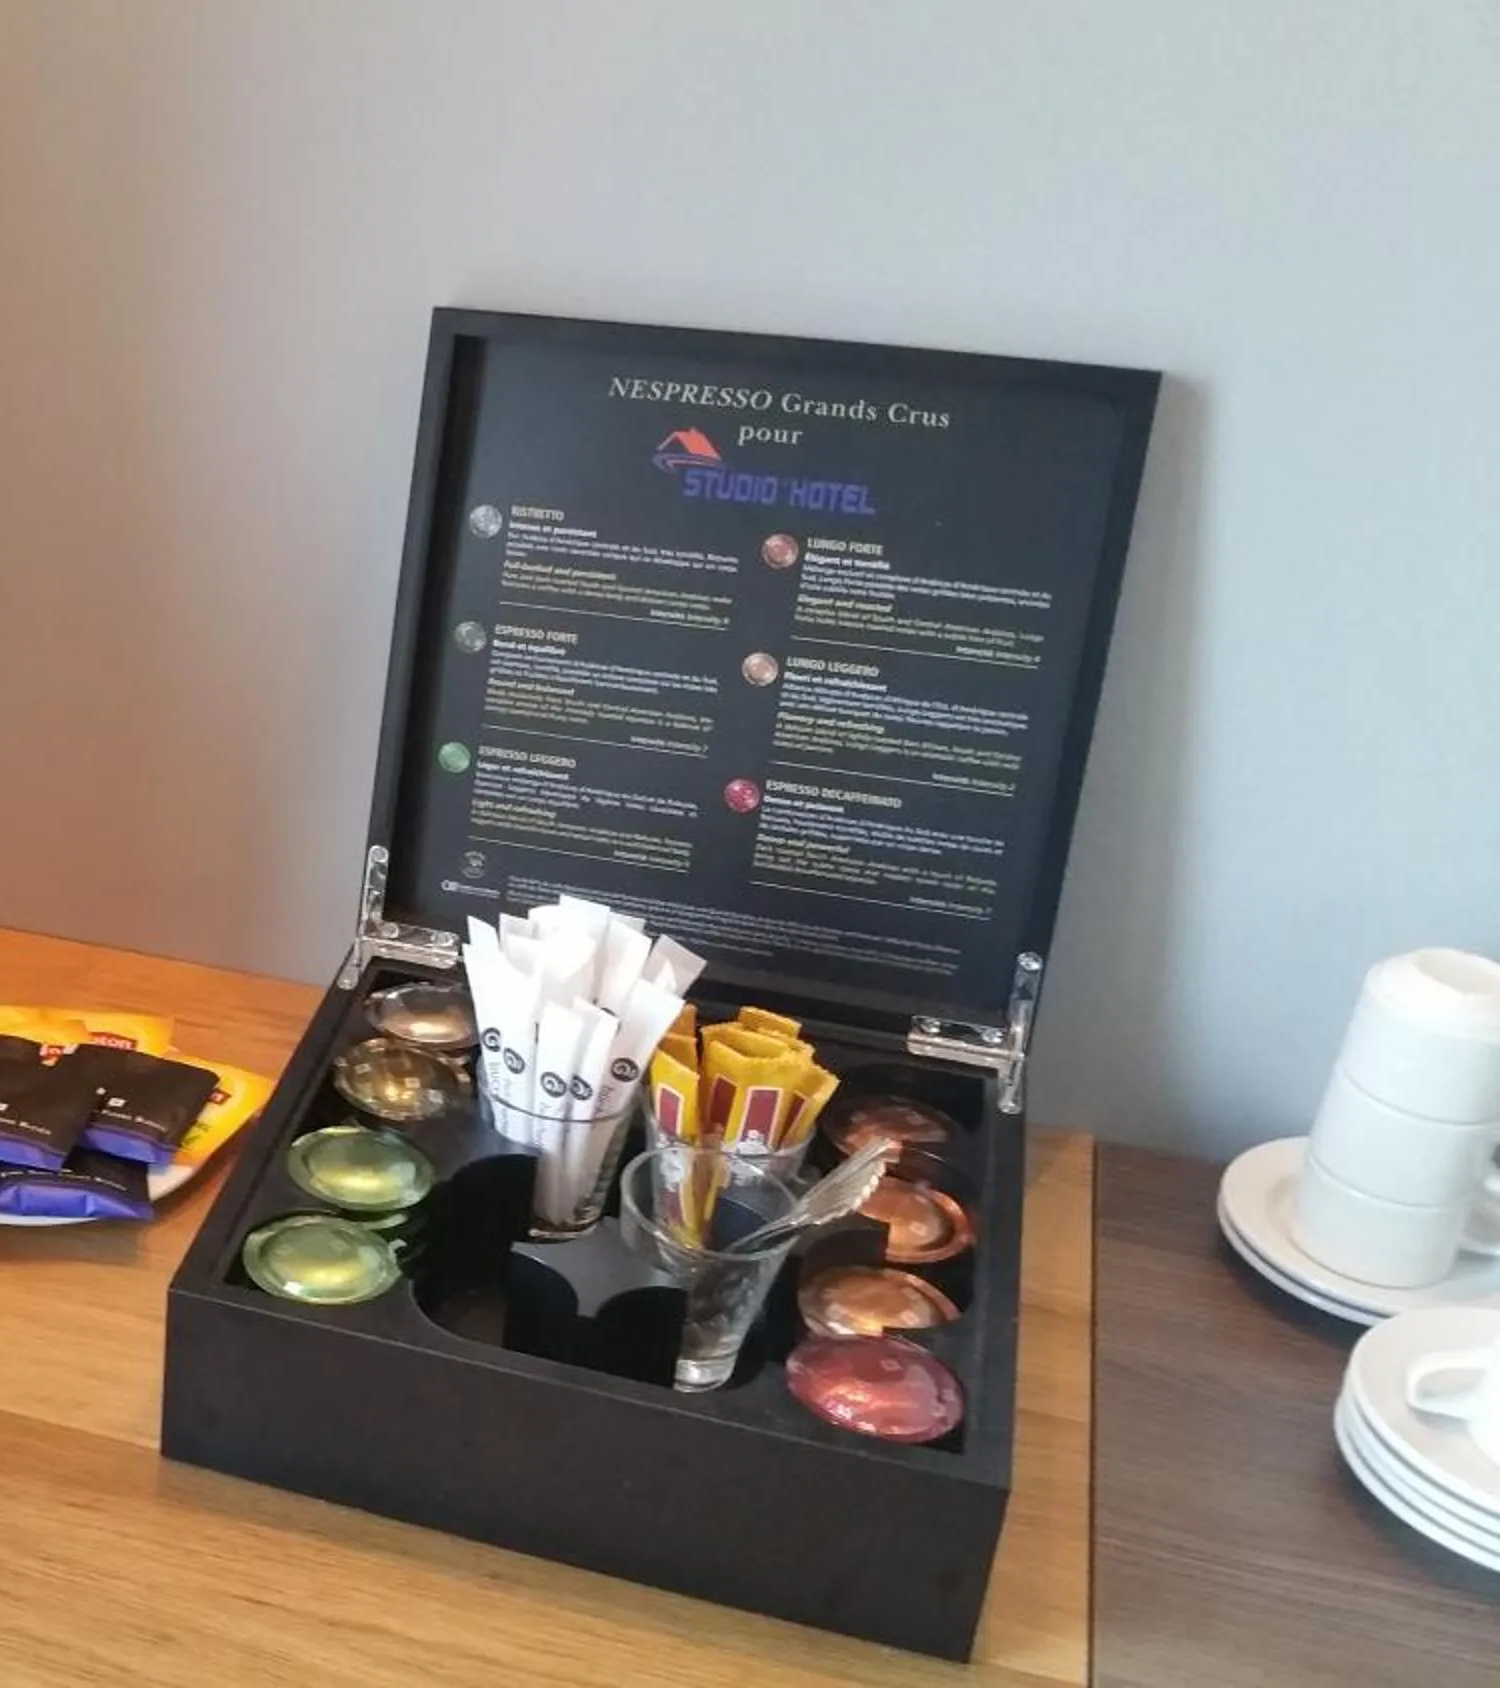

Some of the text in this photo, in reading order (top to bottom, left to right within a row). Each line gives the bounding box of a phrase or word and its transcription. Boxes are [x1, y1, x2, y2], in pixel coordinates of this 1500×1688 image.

[607, 376, 951, 429] NESPRESSO Grands Crus
[736, 424, 804, 446] pour
[682, 468, 778, 506] STUDIO
